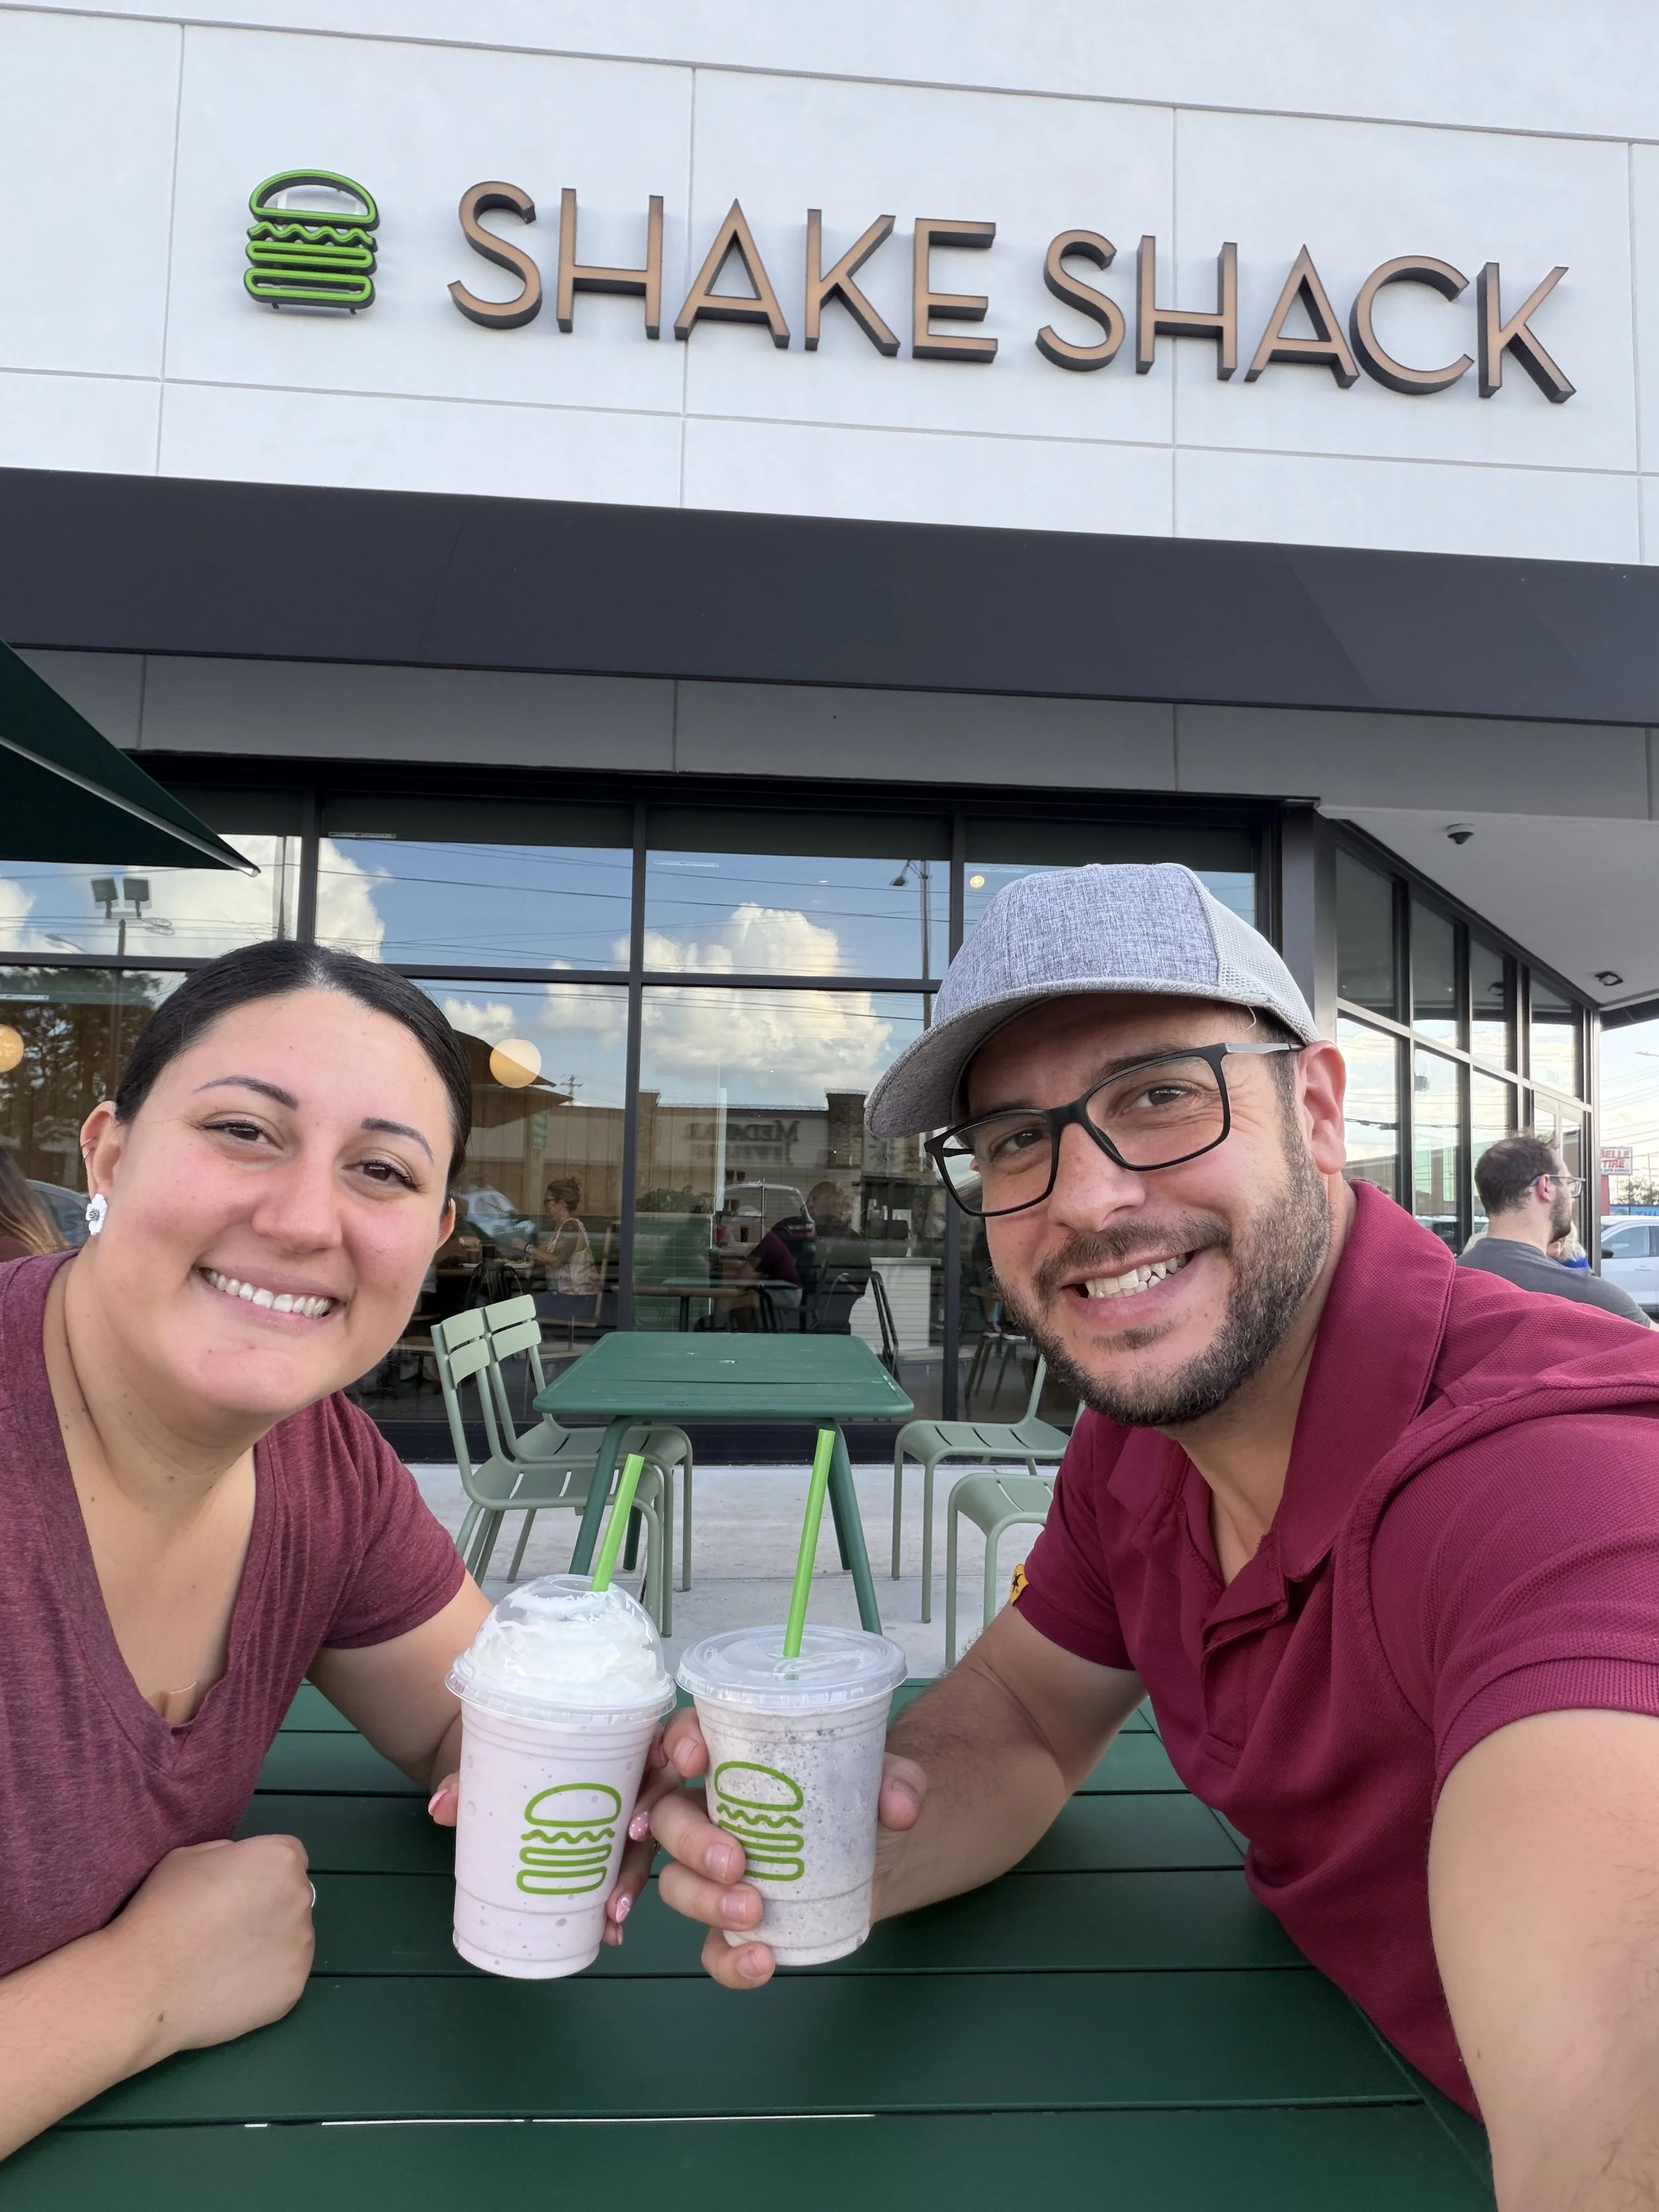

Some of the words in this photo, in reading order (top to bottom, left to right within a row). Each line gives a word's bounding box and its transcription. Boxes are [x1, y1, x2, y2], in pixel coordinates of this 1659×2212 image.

[447, 181, 998, 363] SHAKE
[1035, 229, 1577, 404] SHACK
[1601, 1159, 1624, 1168] TIRE
